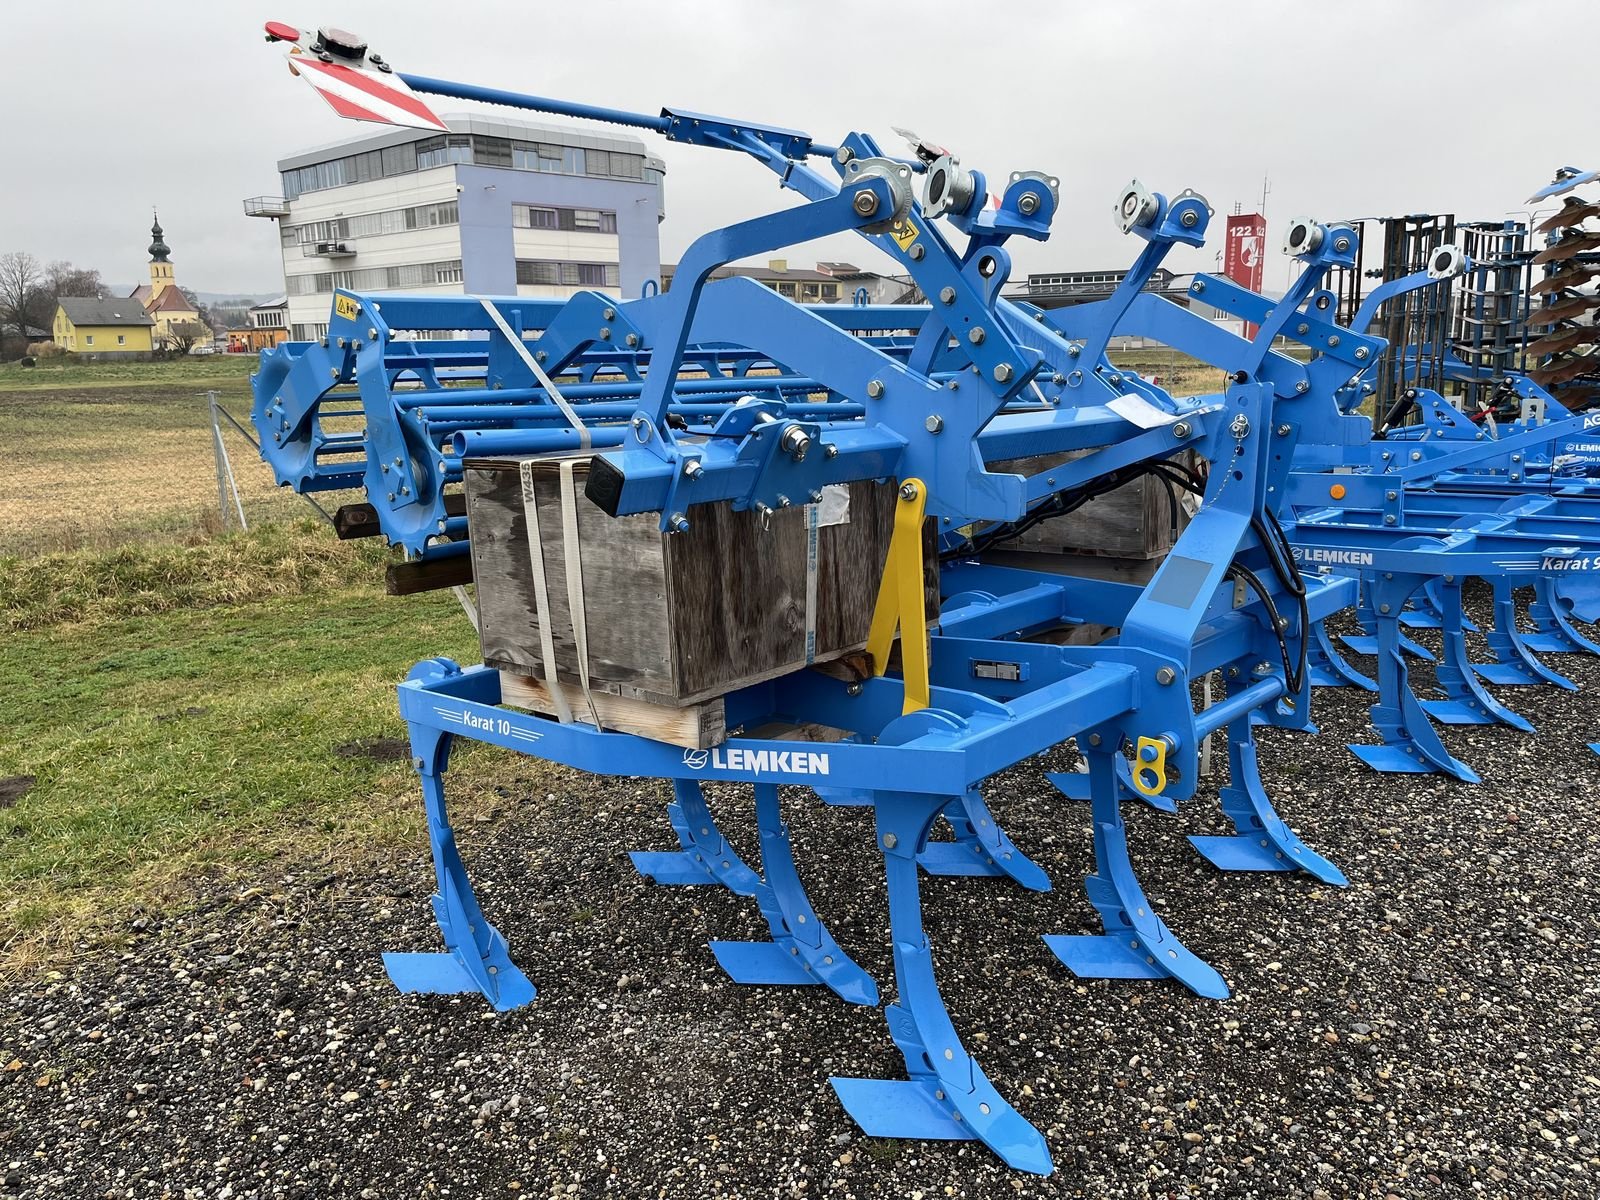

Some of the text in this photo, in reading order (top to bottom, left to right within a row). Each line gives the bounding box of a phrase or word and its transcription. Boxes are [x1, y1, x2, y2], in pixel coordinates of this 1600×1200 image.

[1230, 226, 1252, 237] 122
[521, 463, 534, 503] W435
[1304, 548, 1373, 565] LEMKEN
[1542, 557, 1589, 570] Karat
[463, 710, 510, 736] Karat 10
[712, 748, 829, 776] LEMKEN
